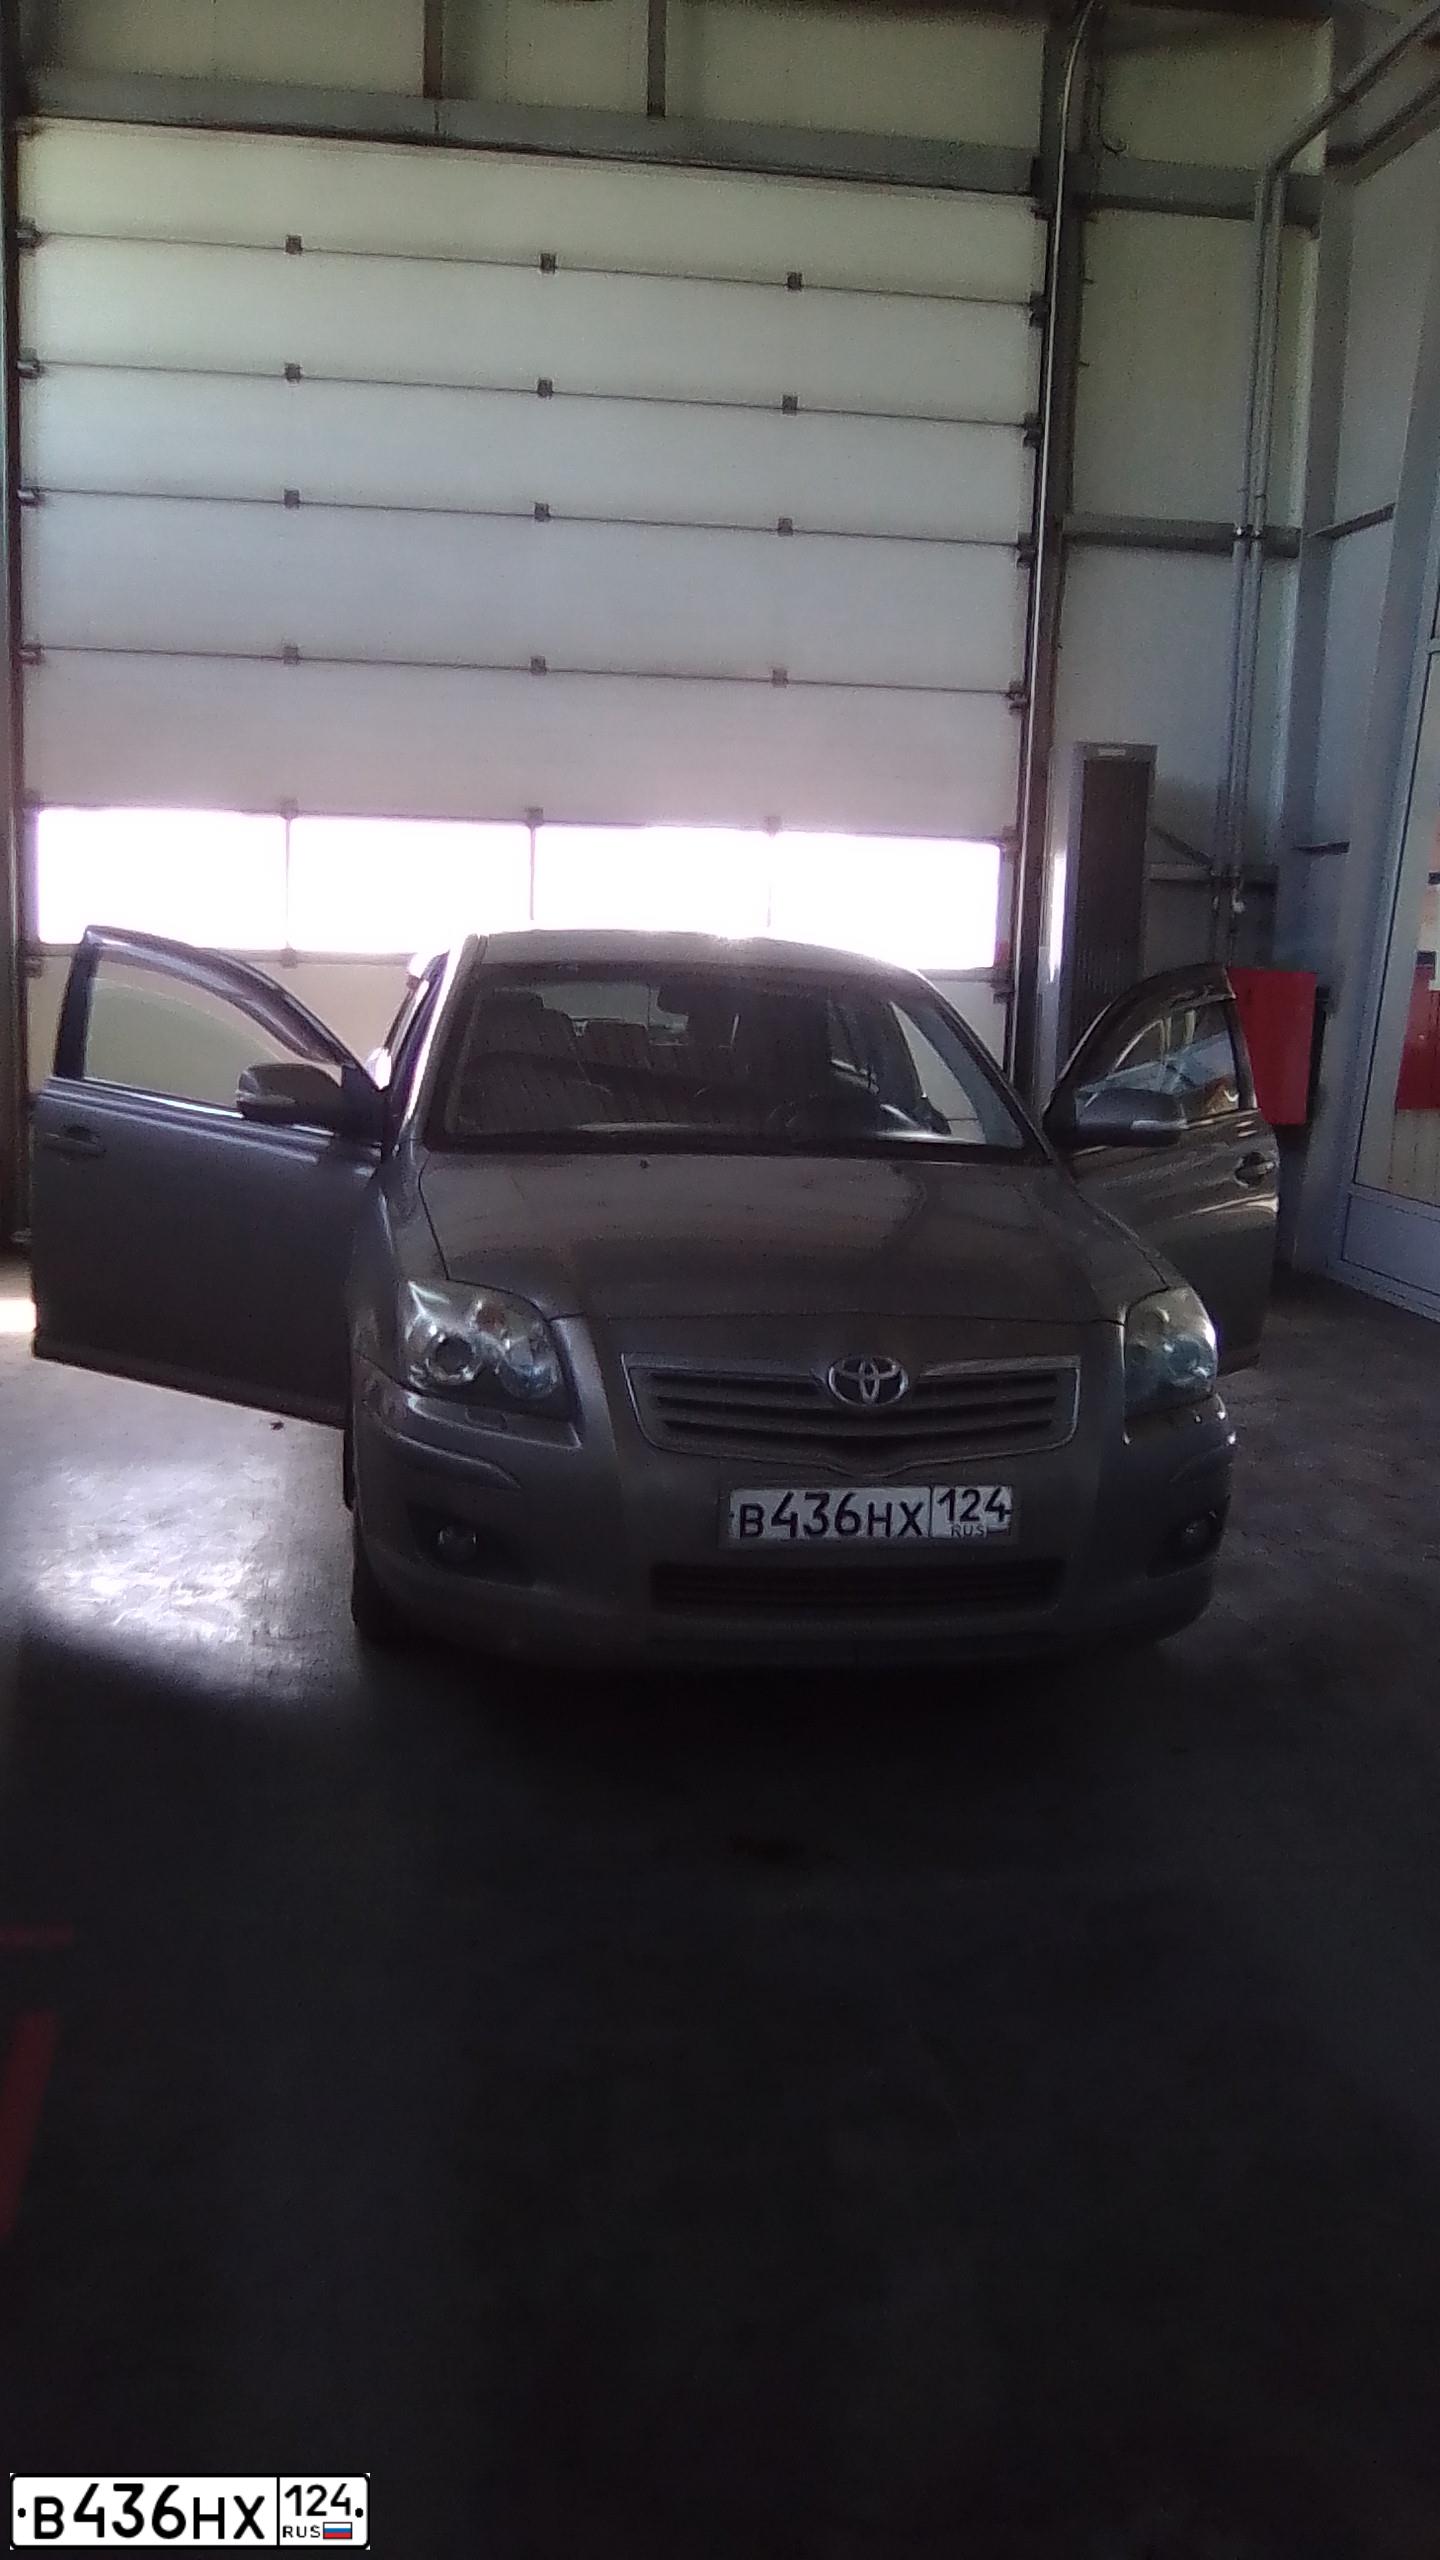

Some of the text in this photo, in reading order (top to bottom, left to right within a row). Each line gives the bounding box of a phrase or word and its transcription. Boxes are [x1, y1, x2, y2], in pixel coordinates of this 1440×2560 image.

[739, 1487, 1008, 1539] В436НХ 124
[950, 1524, 986, 1537] RUS
